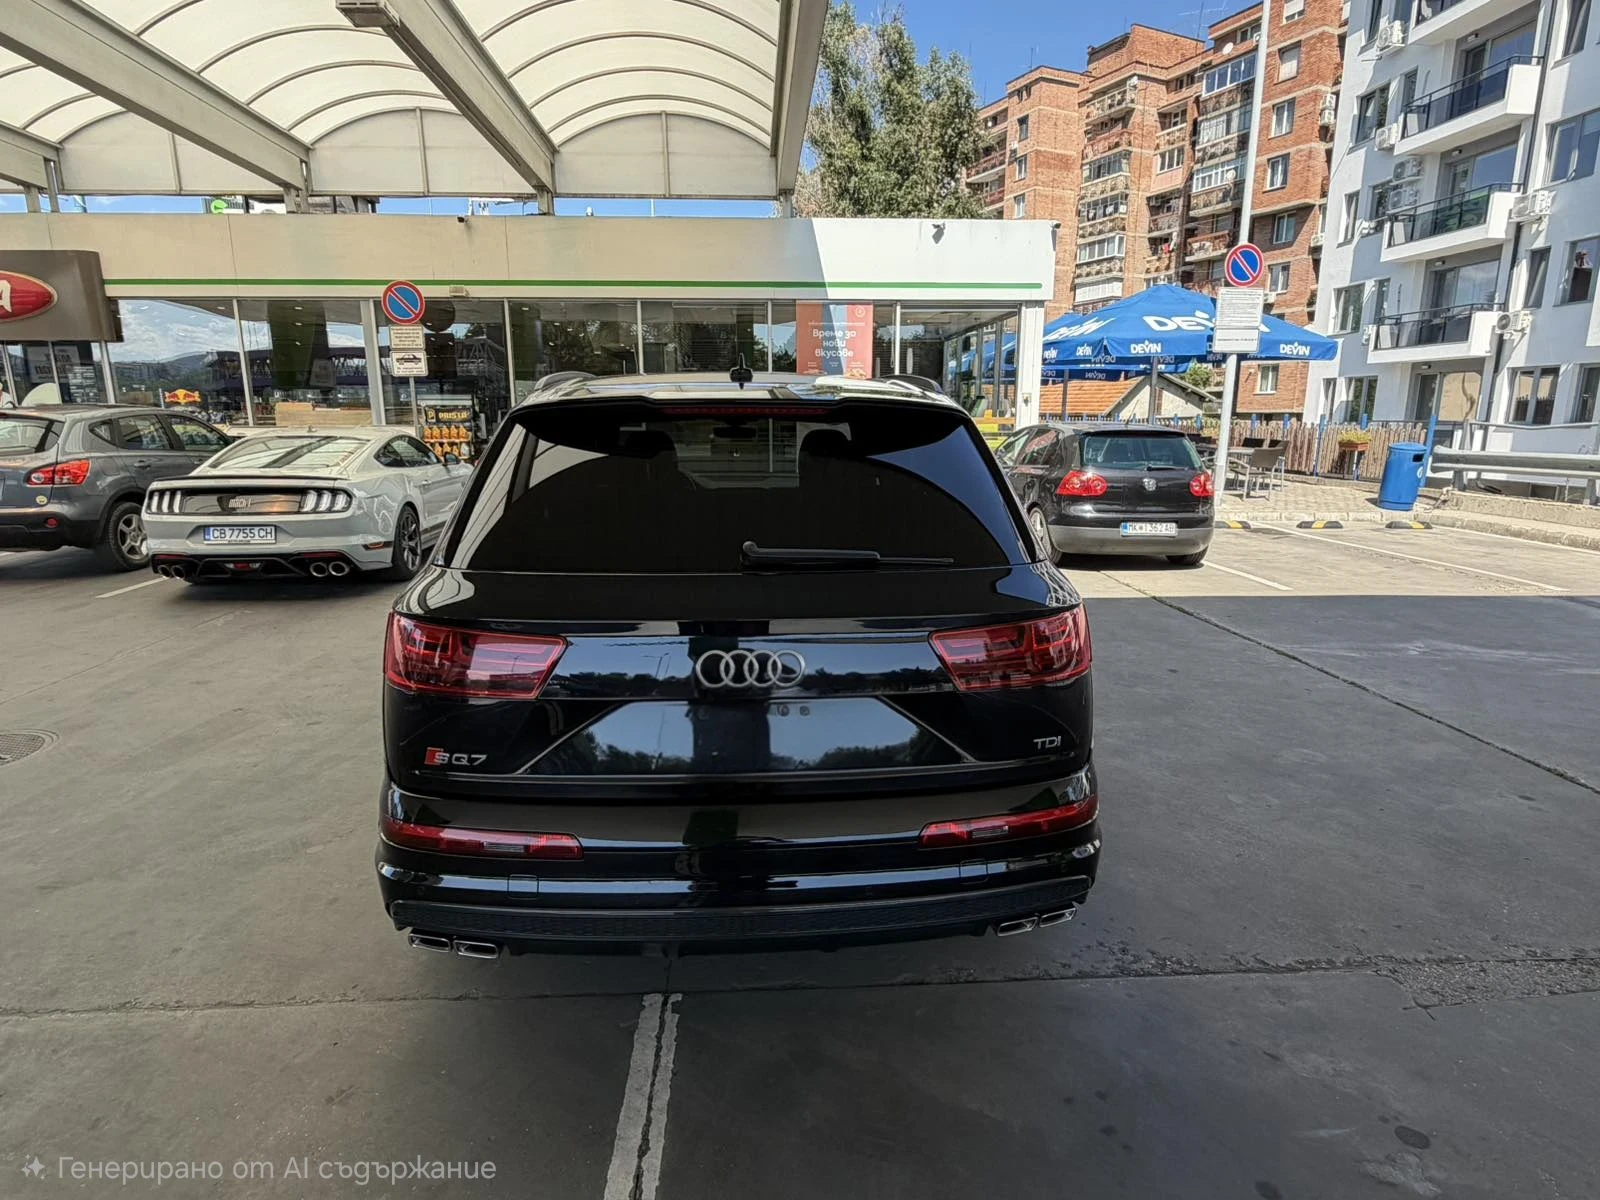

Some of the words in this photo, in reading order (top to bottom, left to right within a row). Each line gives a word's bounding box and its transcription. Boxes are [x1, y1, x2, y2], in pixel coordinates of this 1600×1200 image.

[812, 328, 843, 339] Време
[844, 330, 857, 339] за
[823, 339, 846, 348] нови
[1130, 340, 1162, 354] DEVIN
[1279, 342, 1311, 356] DEVIN
[815, 348, 854, 359] вкусове
[1075, 344, 1093, 356] DEVIN
[212, 528, 226, 539] CB
[228, 528, 256, 539] 7755
[257, 528, 273, 539] CH
[1033, 736, 1062, 750] TDI
[431, 752, 488, 766] SQ7
